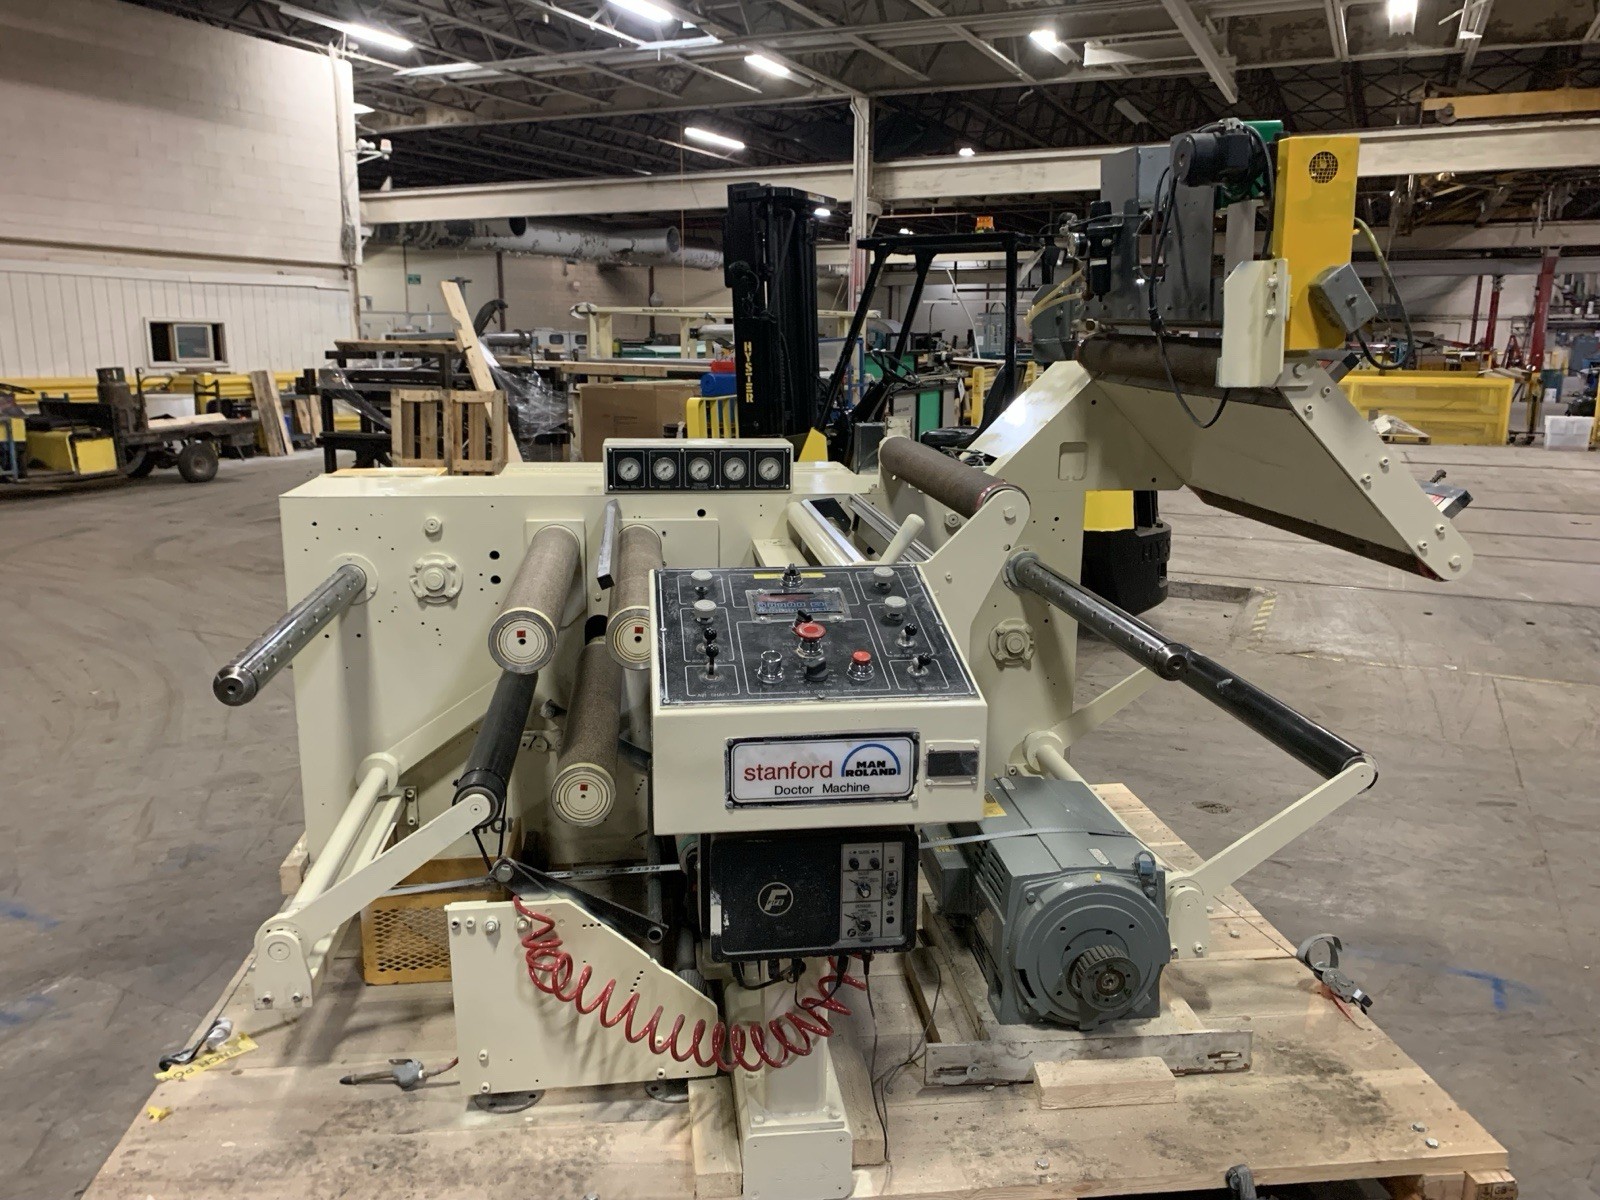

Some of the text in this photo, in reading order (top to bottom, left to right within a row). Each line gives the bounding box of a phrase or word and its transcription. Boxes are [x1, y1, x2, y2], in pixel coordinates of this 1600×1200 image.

[743, 341, 754, 404] HYSTER
[856, 760, 886, 769] MAN
[743, 760, 833, 782] stanford
[845, 767, 897, 778] ROLAND
[774, 784, 814, 796] Doctor
[822, 782, 871, 794] Machine
